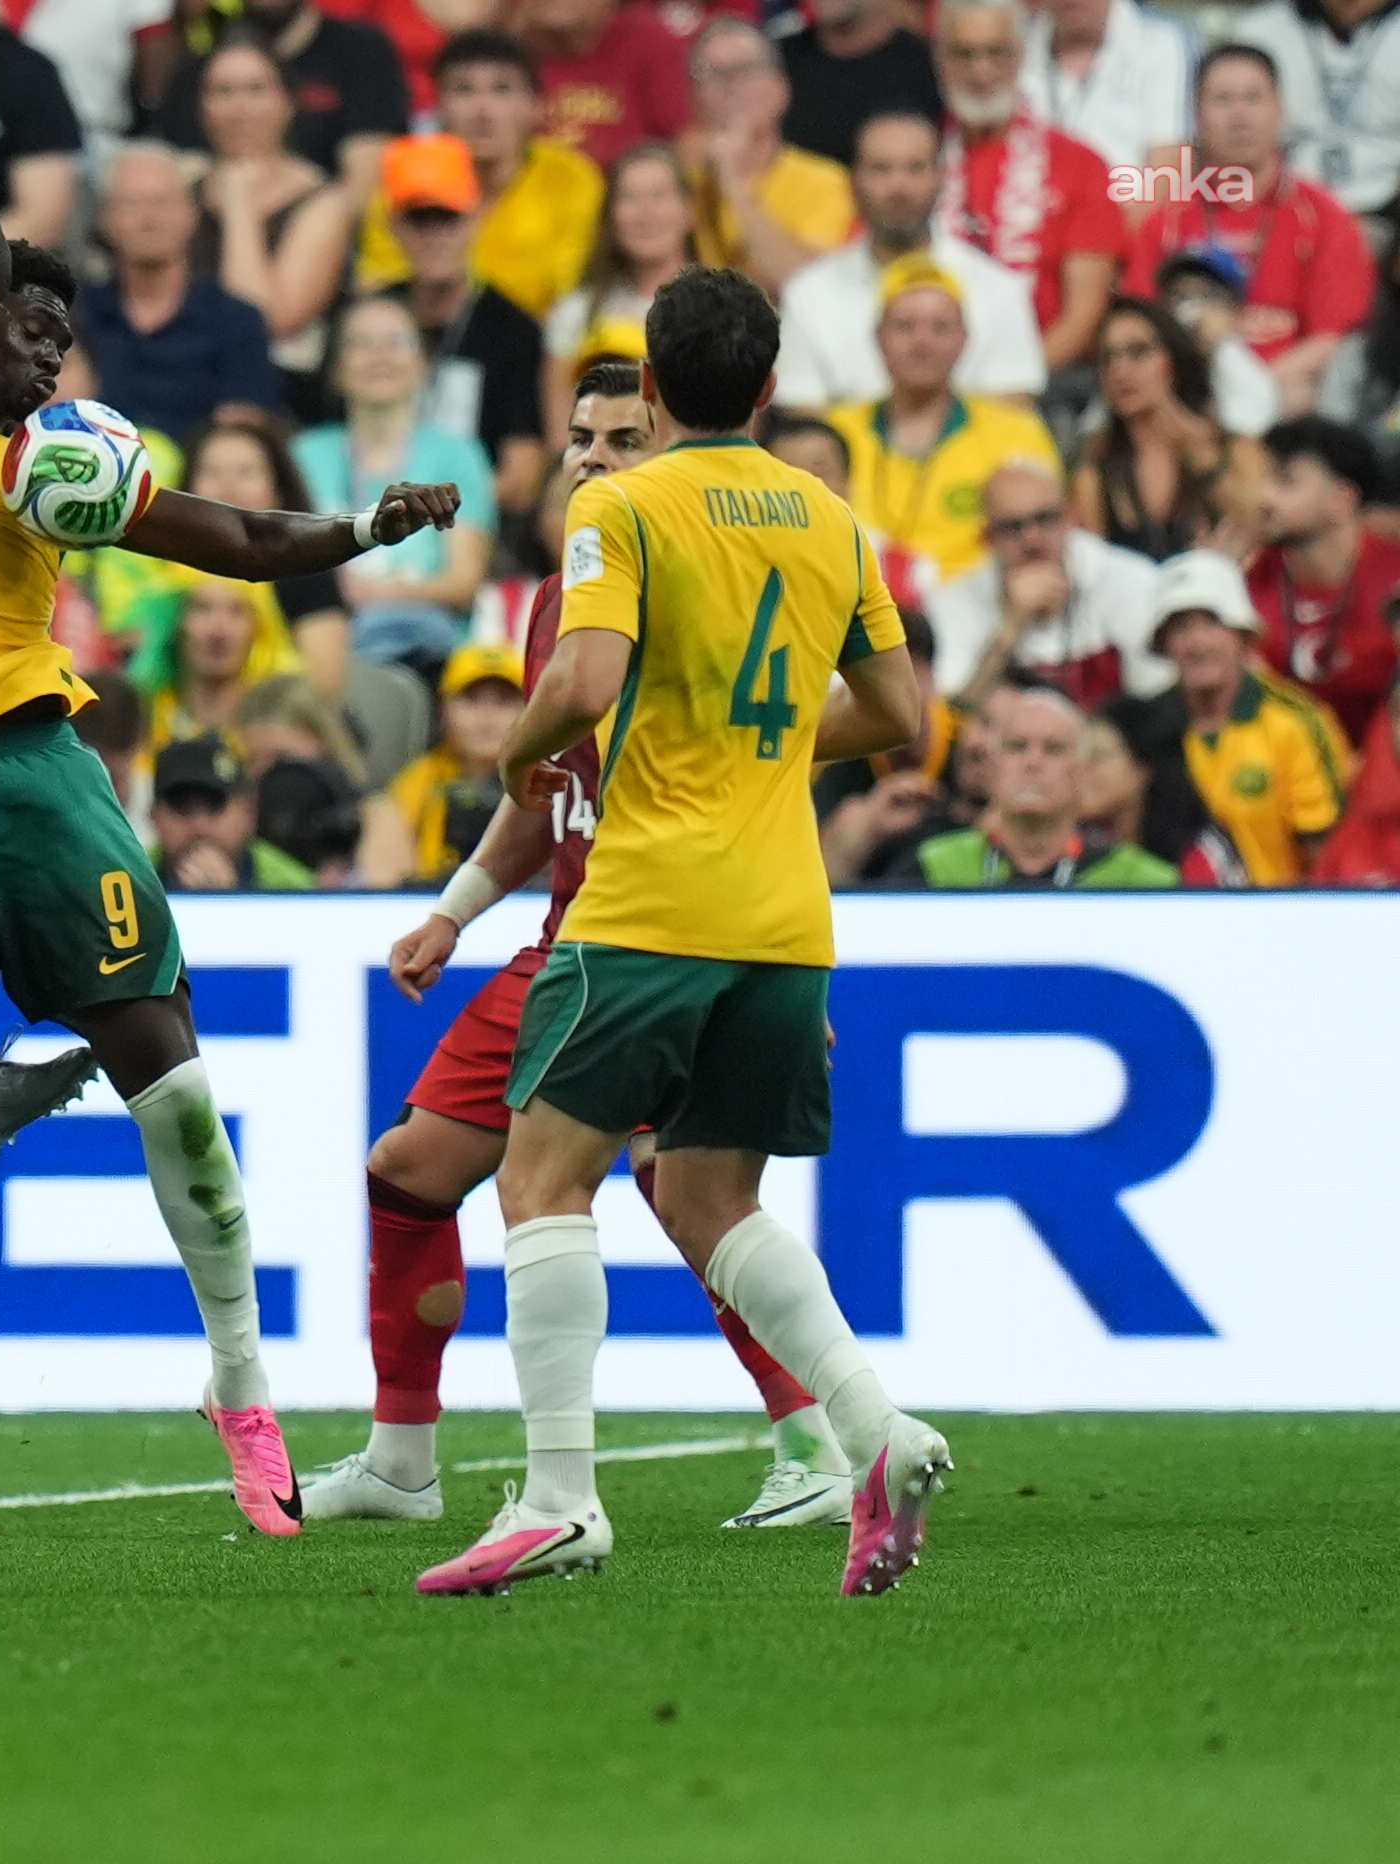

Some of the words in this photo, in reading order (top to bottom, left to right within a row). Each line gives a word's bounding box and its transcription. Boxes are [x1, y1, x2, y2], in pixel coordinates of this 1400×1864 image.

[704, 487, 809, 529] ITALIANO
[729, 566, 798, 761] 4
[551, 771, 598, 844] 14
[101, 870, 140, 949] 9
